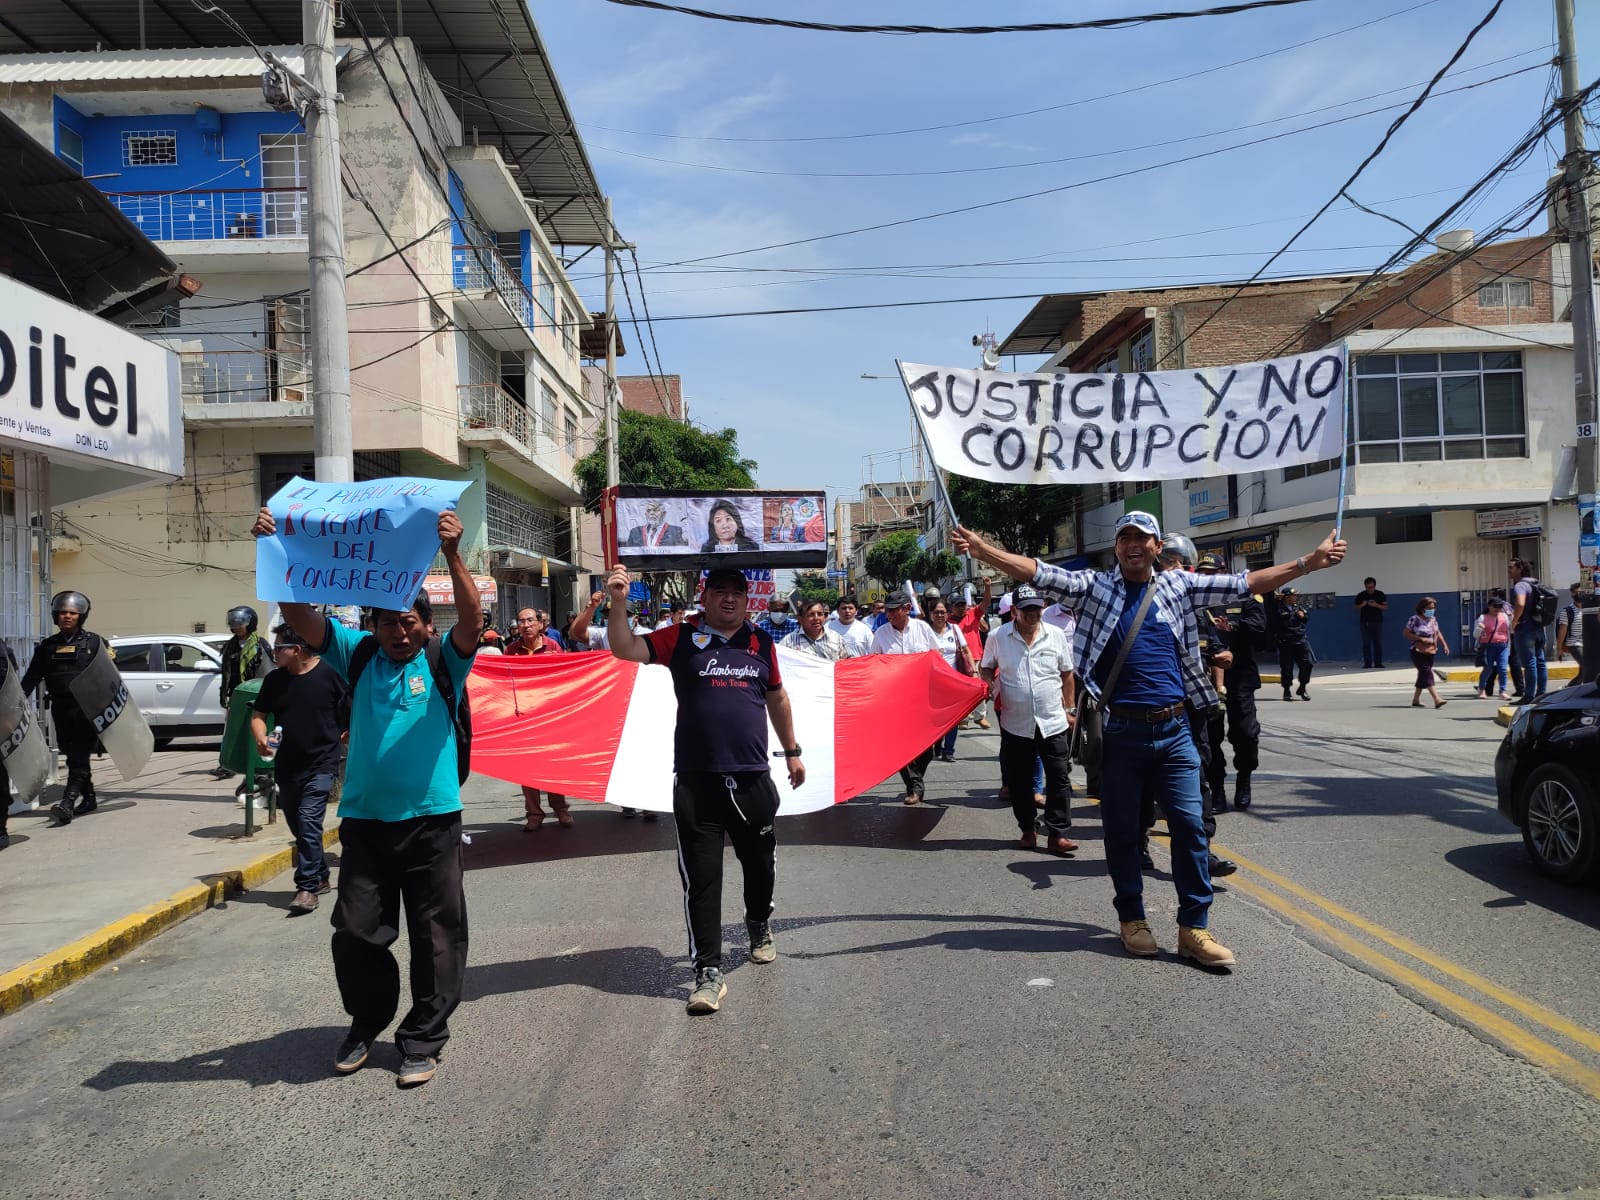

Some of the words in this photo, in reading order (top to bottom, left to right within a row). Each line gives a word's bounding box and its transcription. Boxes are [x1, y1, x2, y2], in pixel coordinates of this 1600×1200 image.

[1193, 369, 1237, 418] Y
[1257, 355, 1342, 411] NO
[25, 420, 51, 437] Ventas
[75, 433, 92, 447] DON
[94, 438, 109, 451] LEO
[286, 486, 319, 501] EL
[331, 540, 390, 566] DEL
[698, 658, 760, 679] Lamborghini
[711, 679, 727, 687] Polo
[93, 684, 128, 732] POLIC
